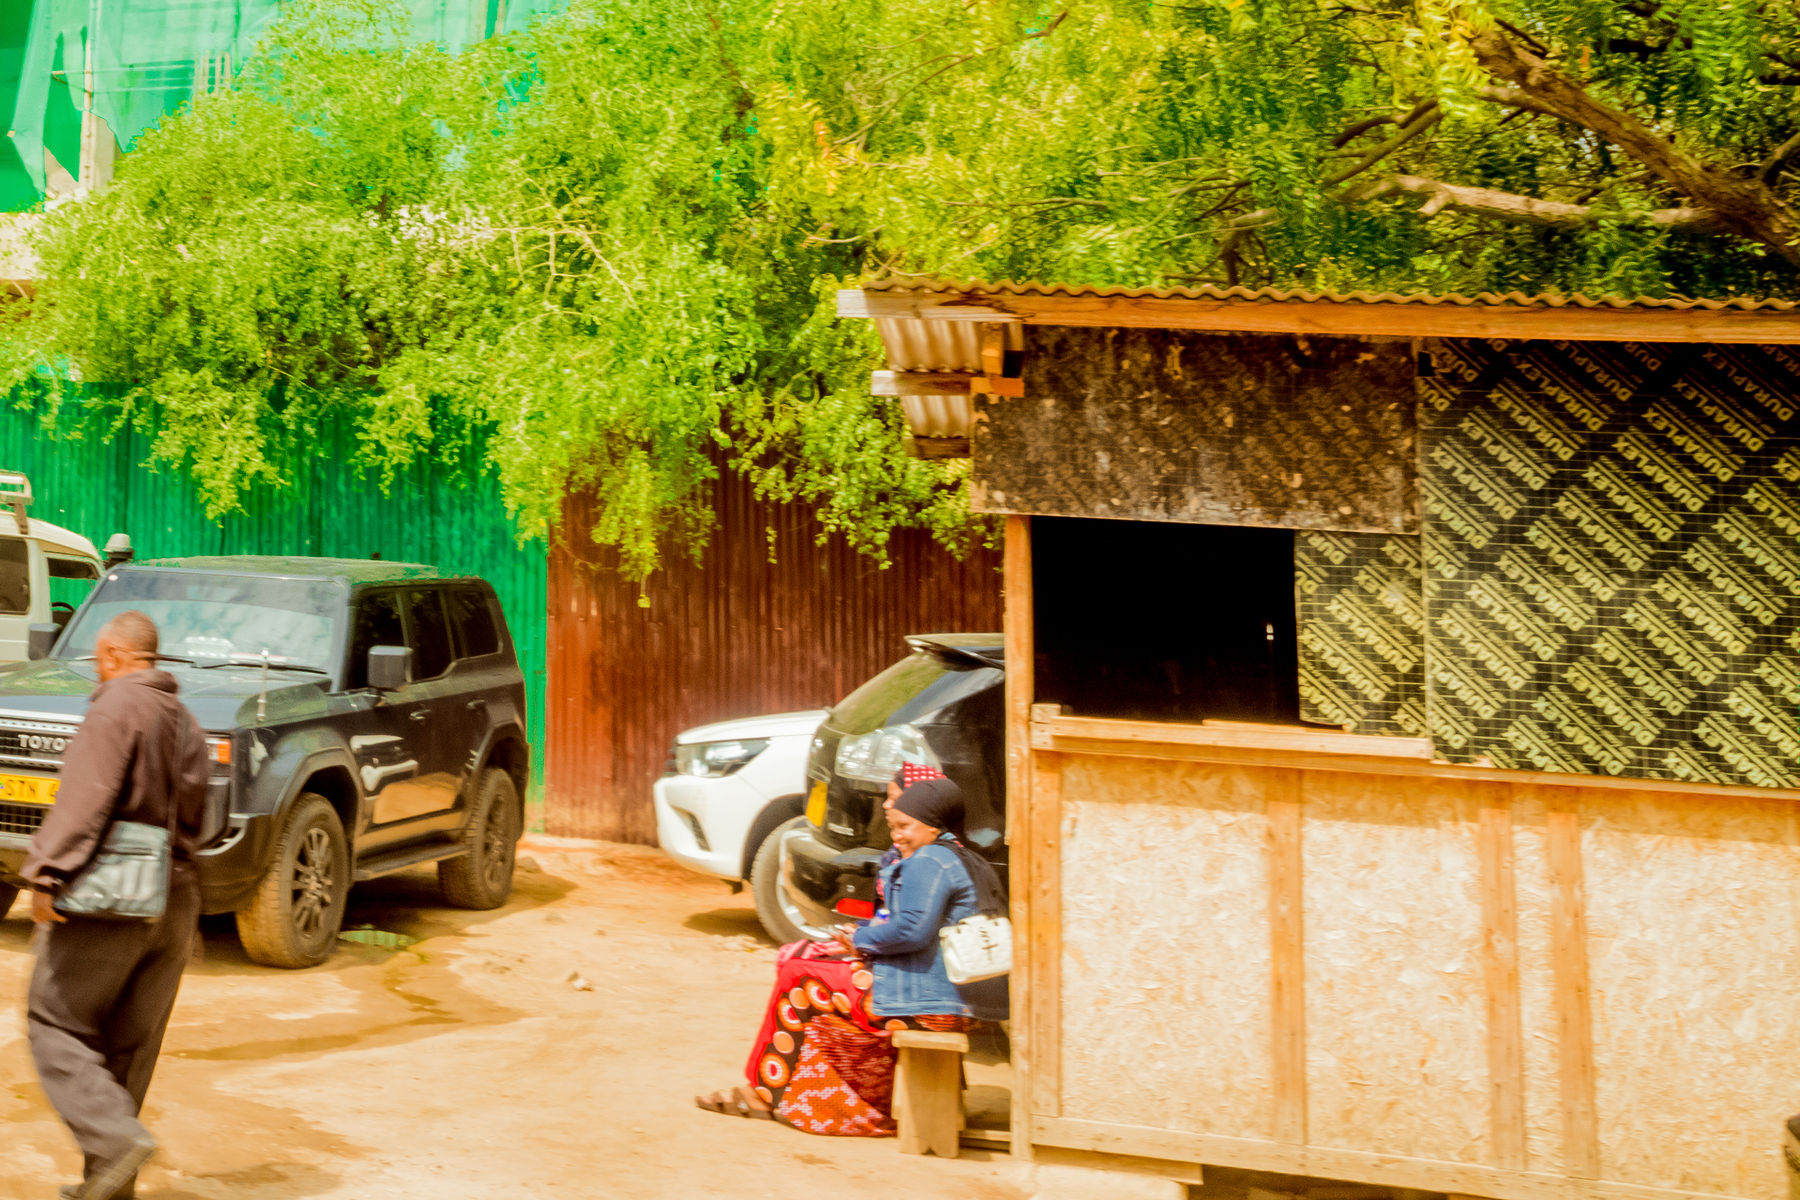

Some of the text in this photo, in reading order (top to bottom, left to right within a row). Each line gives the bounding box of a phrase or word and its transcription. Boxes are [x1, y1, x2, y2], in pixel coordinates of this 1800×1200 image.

[1515, 360, 1604, 431] DURAPLEX
[1553, 341, 1633, 401] DURAPLE
[1702, 349, 1794, 421] DURAPLEX
[1486, 388, 1575, 461] DURAPLEX
[1641, 407, 1735, 482] DURAPLEX
[1672, 378, 1765, 452] DURAPLEX
[1429, 446, 1517, 520] DURAPLEX
[1458, 417, 1546, 491] DURAPLEX
[1612, 436, 1704, 512] DURAPLEX
[1421, 486, 1488, 549] DURAPL
[1553, 496, 1645, 572] DURAPLEX
[1582, 466, 1675, 542] DURAPLEX
[1741, 487, 1800, 541] APLEX
[1494, 554, 1586, 632] DURAPLEX
[1523, 525, 1616, 602] DURAPLEX
[1681, 548, 1777, 626] DURAPLEX
[1325, 597, 1415, 674] DURAPLEX
[1436, 613, 1527, 690] DURAPLEX
[1465, 583, 1556, 661] DURAPLEX
[1620, 607, 1717, 686] DURAPLEX
[1651, 578, 1747, 656] DURAPLEX
[1297, 627, 1387, 704] DURAPLEX
[1430, 657, 1498, 720] DURAPL
[1591, 637, 1686, 716] DURAPLEX
[18, 734, 73, 752] TOYO
[1531, 696, 1625, 775] DURAPLEX
[1561, 666, 1656, 746] DURAPLEX
[1501, 725, 1561, 772] APLEX
